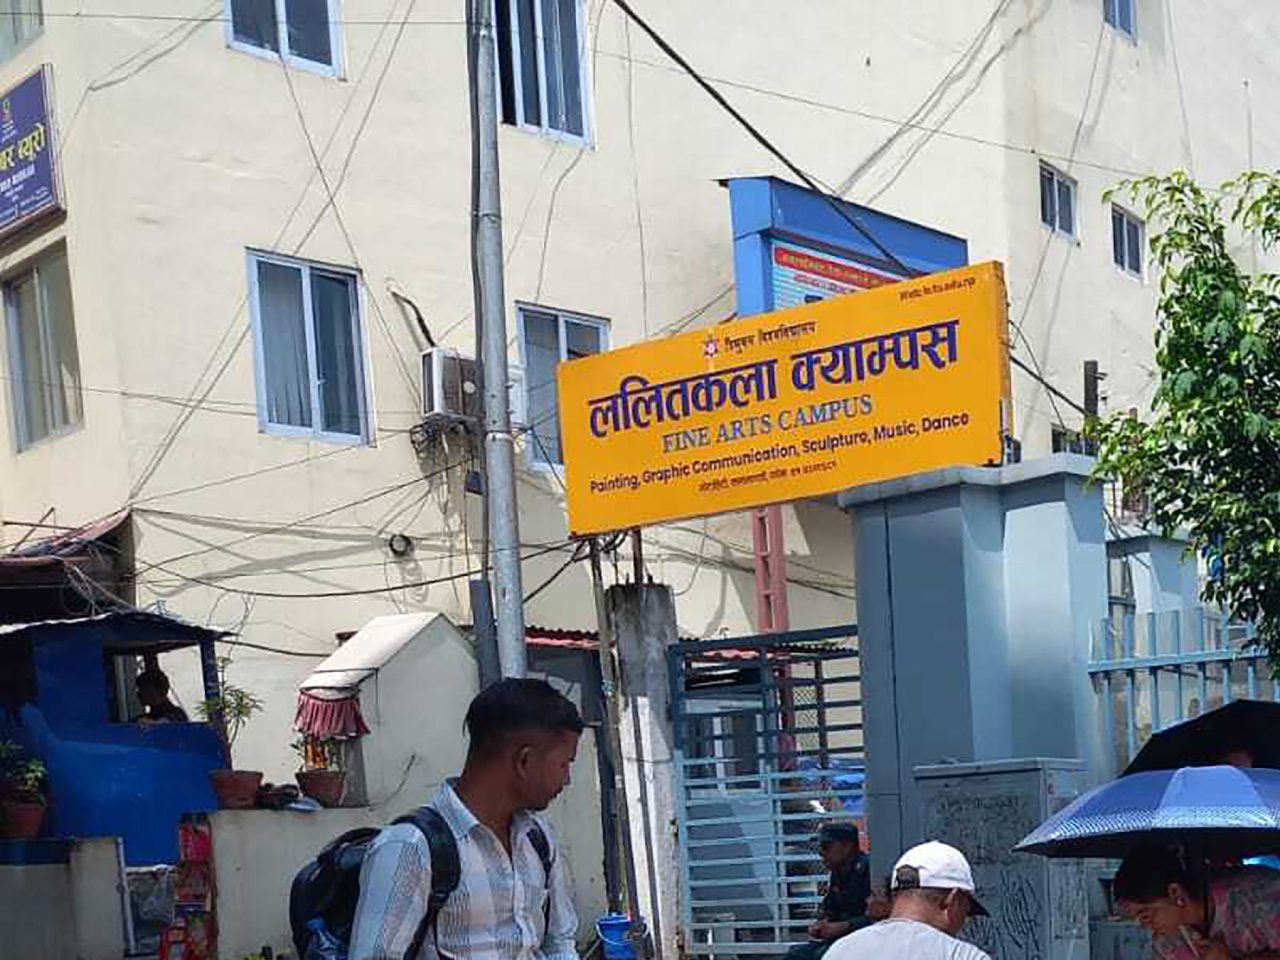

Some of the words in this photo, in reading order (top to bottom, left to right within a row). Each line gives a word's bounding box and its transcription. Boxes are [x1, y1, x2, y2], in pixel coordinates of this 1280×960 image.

[588, 358, 779, 438] ललितकला
[790, 319, 960, 392] क्याम्पस
[589, 472, 641, 493] Painting,
[642, 461, 691, 484] Graphic
[692, 442, 798, 474] Communication,
[801, 430, 871, 454] Sculpture,
[873, 420, 919, 441] Music,
[921, 412, 970, 433] Dance
[662, 426, 711, 453] FINE
[717, 414, 772, 443] ARTS
[778, 394, 873, 431] CAMPUS
